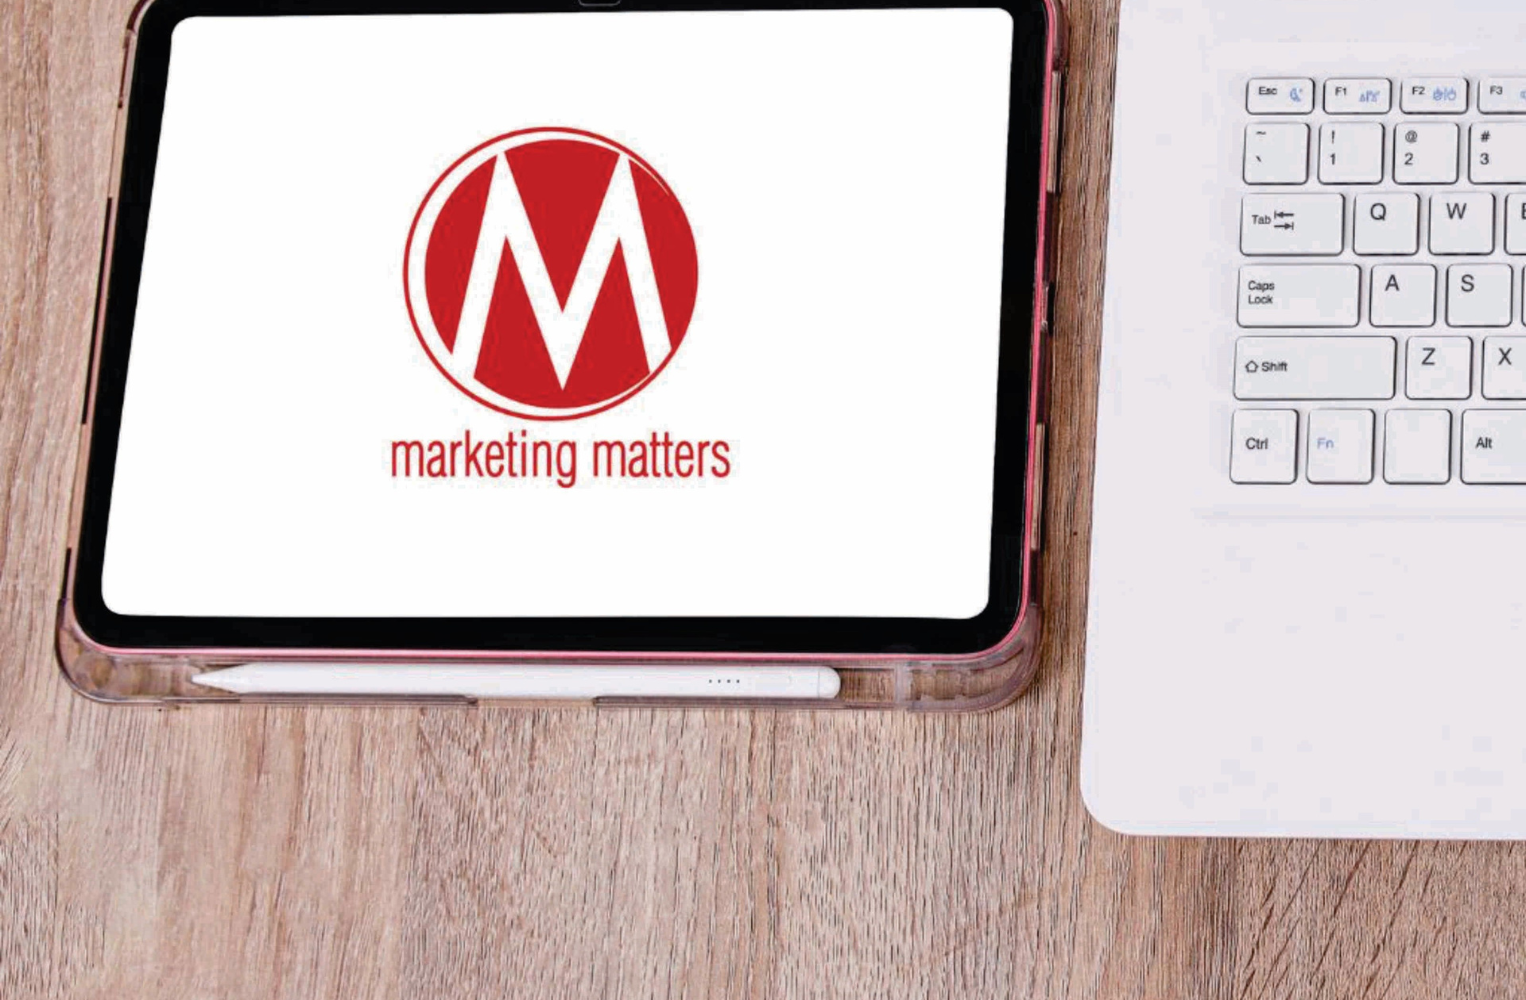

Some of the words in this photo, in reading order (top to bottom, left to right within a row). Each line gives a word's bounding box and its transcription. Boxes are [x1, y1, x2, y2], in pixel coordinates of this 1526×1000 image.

[1258, 86, 1278, 96] Esc
[1334, 86, 1347, 96] F1
[1411, 86, 1426, 96] F2
[1489, 85, 1503, 96] F3
[1404, 152, 1414, 166] 2
[1480, 152, 1490, 166] 3
[1369, 202, 1387, 221] Q
[1446, 202, 1467, 220] W
[1251, 214, 1272, 225] Tab
[1247, 279, 1275, 292] Caps
[1384, 274, 1400, 292] A
[1460, 273, 1475, 293] S
[1247, 294, 1274, 305] Lock
[1421, 347, 1436, 366] Z
[1498, 347, 1512, 366] X
[1261, 361, 1288, 373] Shift
[1245, 436, 1269, 451] Ctrl
[1316, 437, 1335, 449] Fn
[1475, 436, 1493, 449] Alt
[391, 430, 576, 488] marketing
[593, 431, 731, 478] matters
